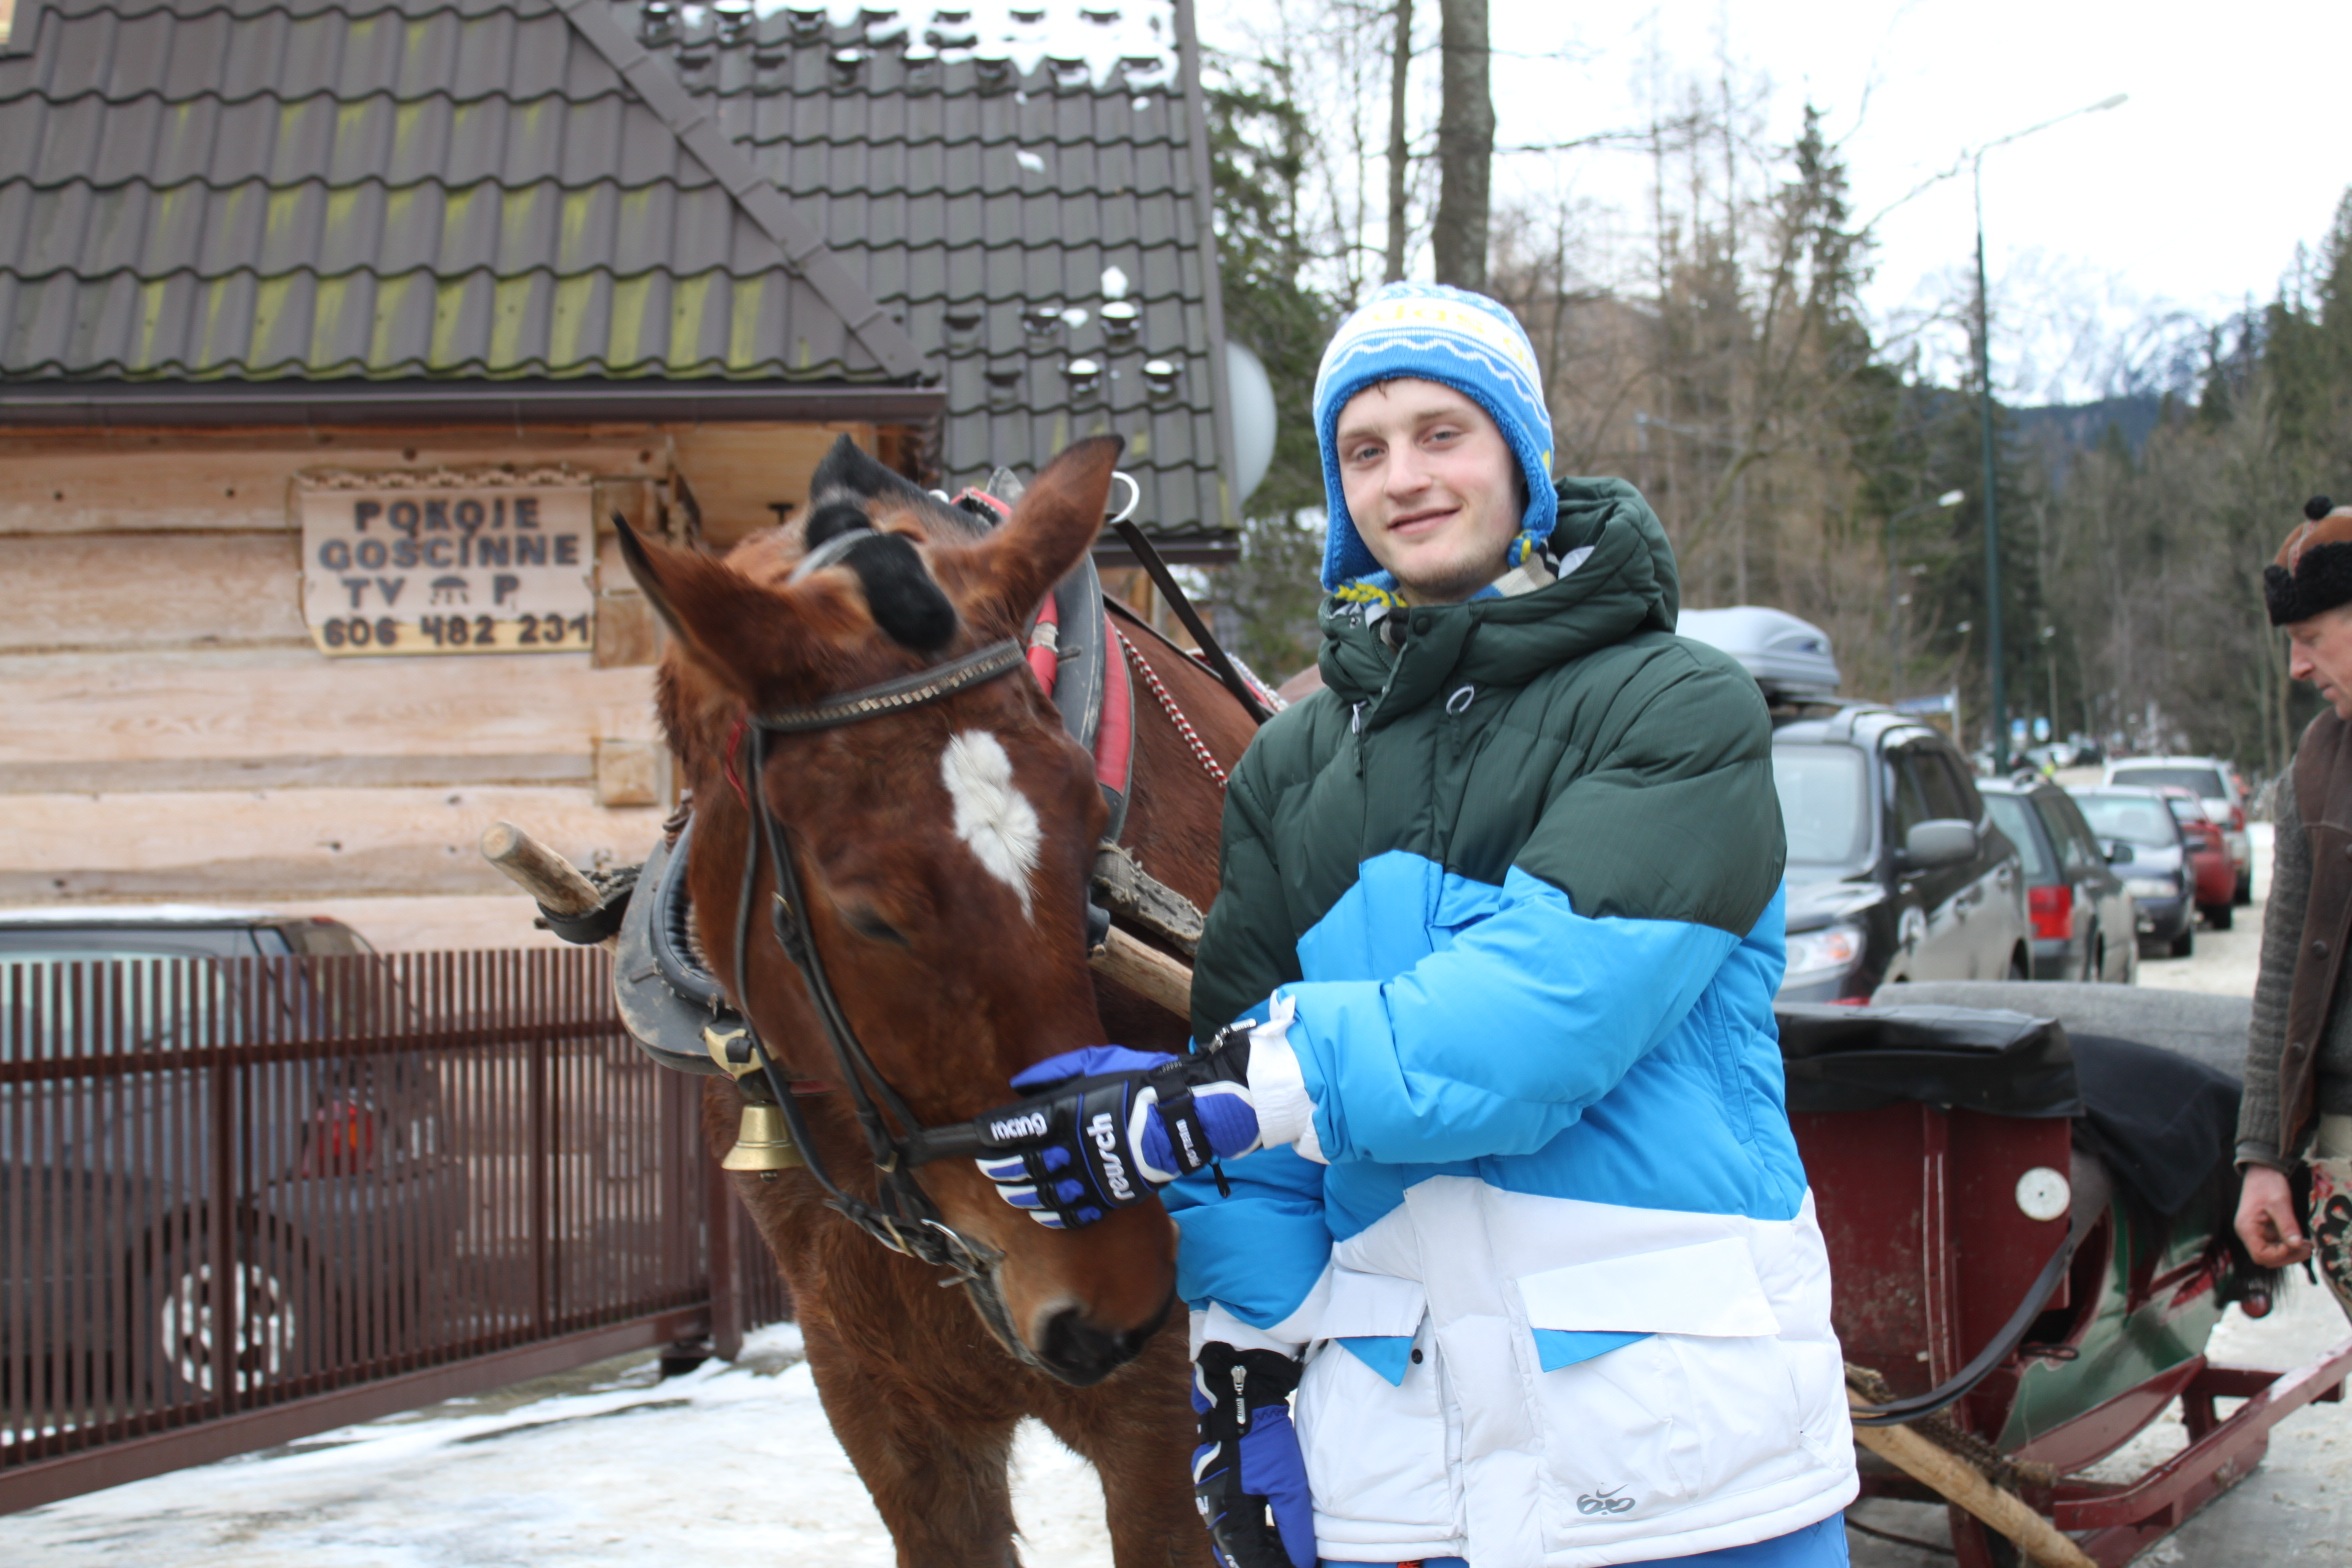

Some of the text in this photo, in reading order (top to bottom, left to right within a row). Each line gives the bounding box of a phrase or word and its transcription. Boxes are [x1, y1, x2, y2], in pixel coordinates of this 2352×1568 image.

[341, 573, 520, 609] TV P
[323, 613, 589, 647] 606 482 231
[1086, 1112, 1136, 1201] reusch
